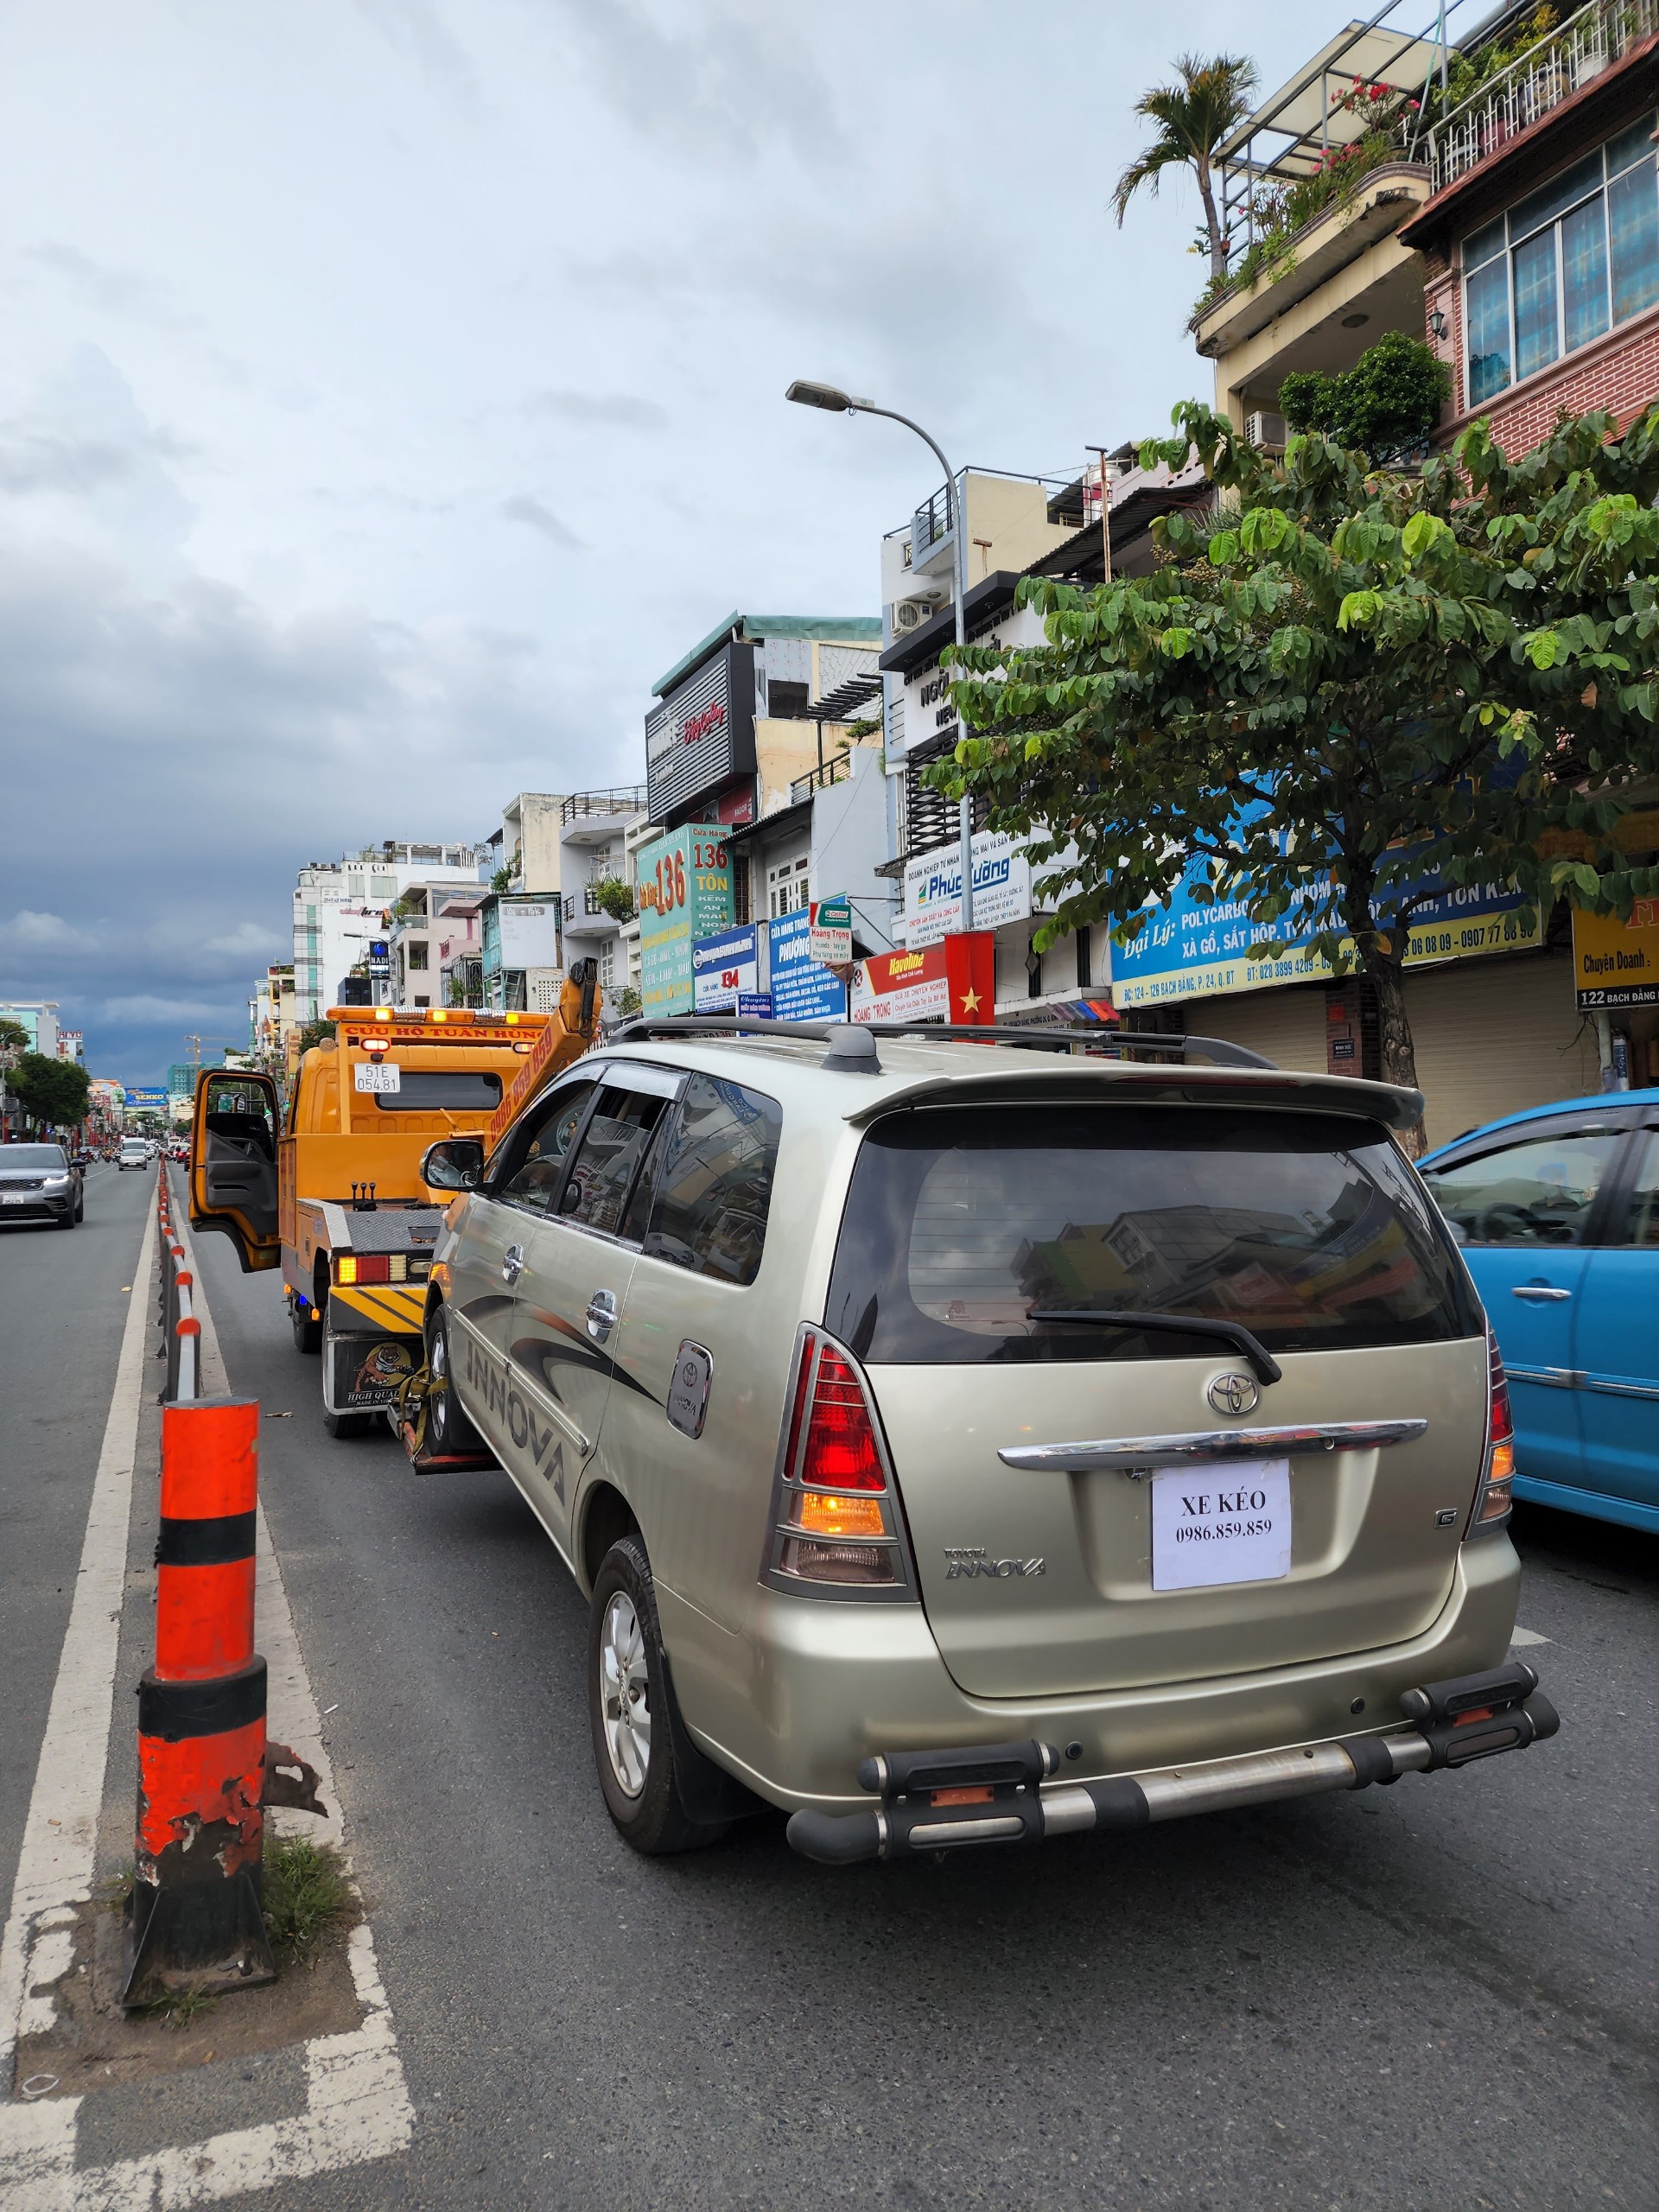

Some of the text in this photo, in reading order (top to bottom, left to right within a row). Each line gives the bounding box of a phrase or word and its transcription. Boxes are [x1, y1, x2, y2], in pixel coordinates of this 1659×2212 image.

[694, 842, 728, 870] 136
[908, 868, 923, 881] DOANH
[923, 861, 940, 877] NGHIỆP
[946, 853, 960, 868] NHÂN
[980, 844, 989, 855] MẠI
[989, 836, 997, 849] VÀ
[656, 848, 686, 916] 136
[696, 873, 728, 892] TÔN
[929, 856, 1010, 900] Phúc ường
[811, 928, 849, 940] Hoàng Trọng
[1123, 918, 1176, 960] Đại Lý:
[1182, 935, 1198, 959] XÀ
[1200, 929, 1221, 956] GỒ,
[1223, 924, 1247, 950] SẮT
[1411, 938, 1423, 957] 06
[1425, 936, 1437, 954] 08
[1440, 932, 1452, 951] 09
[1461, 927, 1485, 949] 0907
[889, 952, 925, 976] Havoline
[1583, 952, 1615, 975] Chuyên
[1617, 949, 1644, 970] Doanh
[721, 969, 739, 988] 134
[1124, 988, 1134, 1001] ĐC:
[1134, 985, 1145, 1001] 124
[1149, 983, 1160, 999] 126
[1160, 981, 1177, 998] BẠCH
[1178, 973, 1197, 993] ĐẰNG,
[1198, 977, 1205, 989] P.
[1205, 973, 1217, 989] 24,
[1217, 971, 1225, 987] Q.
[1226, 969, 1235, 985] BT
[1247, 966, 1258, 982] ĐT:
[1259, 964, 1273, 980] 028
[1274, 962, 1293, 978] 3899
[1581, 988, 1656, 1006] 122 BẠCH ĐẰNG
[854, 1005, 871, 1023] HOÀNG
[873, 1001, 891, 1021] TRỌNG
[345, 1023, 389, 1036] CỨU
[395, 1026, 425, 1038] HỘ
[429, 1026, 487, 1038] TUẤN
[365, 1065, 389, 1078] 51E
[490, 1026, 553, 1143] 0986 859 859
[357, 1078, 397, 1092] 054.81
[347, 1392, 372, 1401] HIGH
[467, 1339, 565, 1508] INNOVA
[1180, 1485, 1267, 1516] XE KÉO
[1176, 1518, 1273, 1544] 0986.859.859
[944, 1548, 987, 1559] TOYOTA
[945, 1558, 1046, 1580] INNOVA
